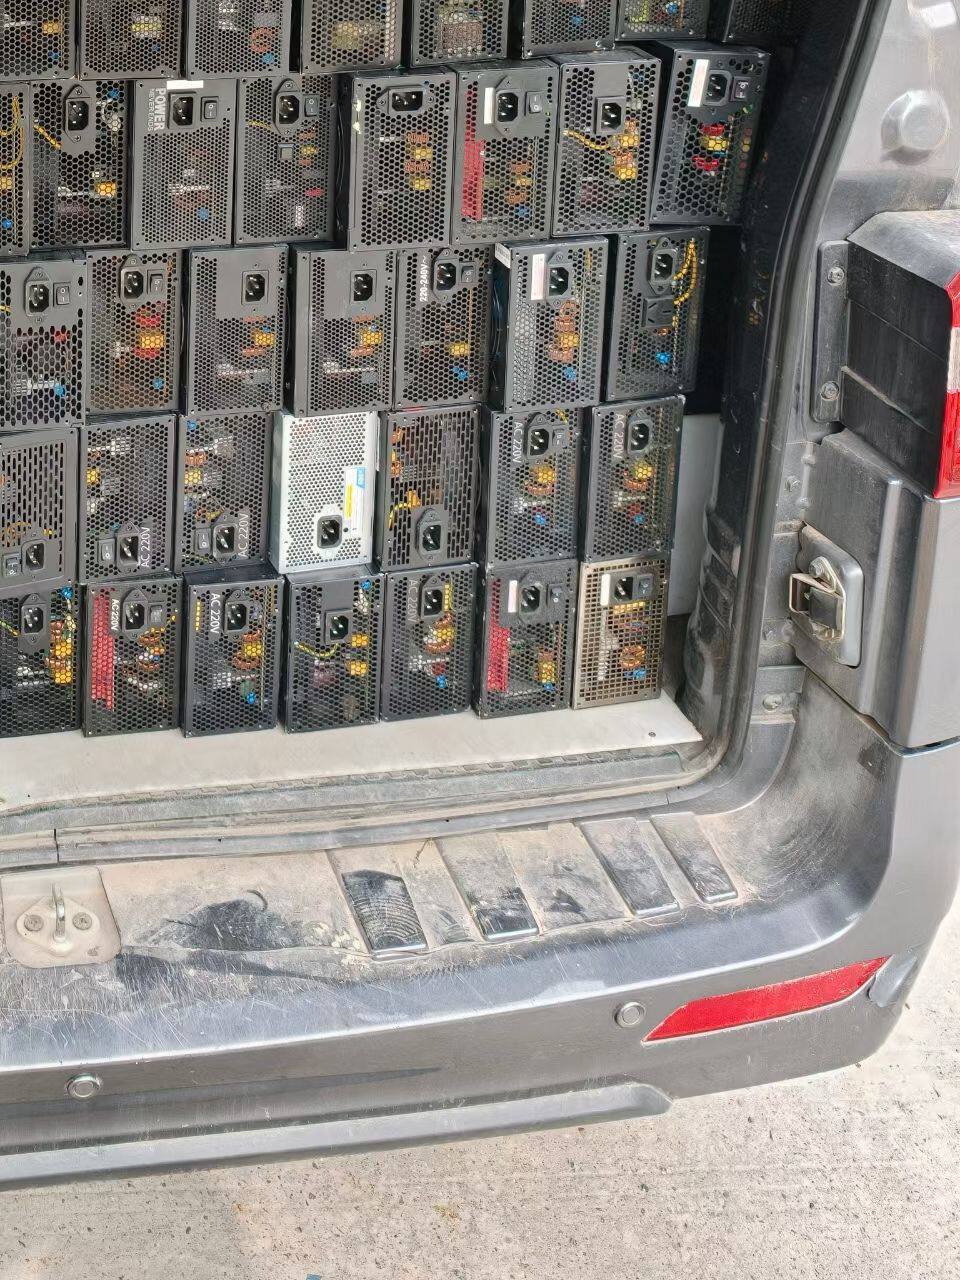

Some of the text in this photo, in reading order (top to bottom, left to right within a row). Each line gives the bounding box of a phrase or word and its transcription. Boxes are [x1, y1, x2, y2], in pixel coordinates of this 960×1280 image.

[147, 112, 155, 131] ENDS
[154, 88, 166, 131] POWER
[513, 422, 522, 463] AC 220V
[613, 414, 624, 458] AC 220V
[140, 527, 150, 567] AC 220V
[239, 513, 248, 557] AC 220V
[211, 593, 220, 633] AC 220V
[408, 580, 417, 621] AC 220V
